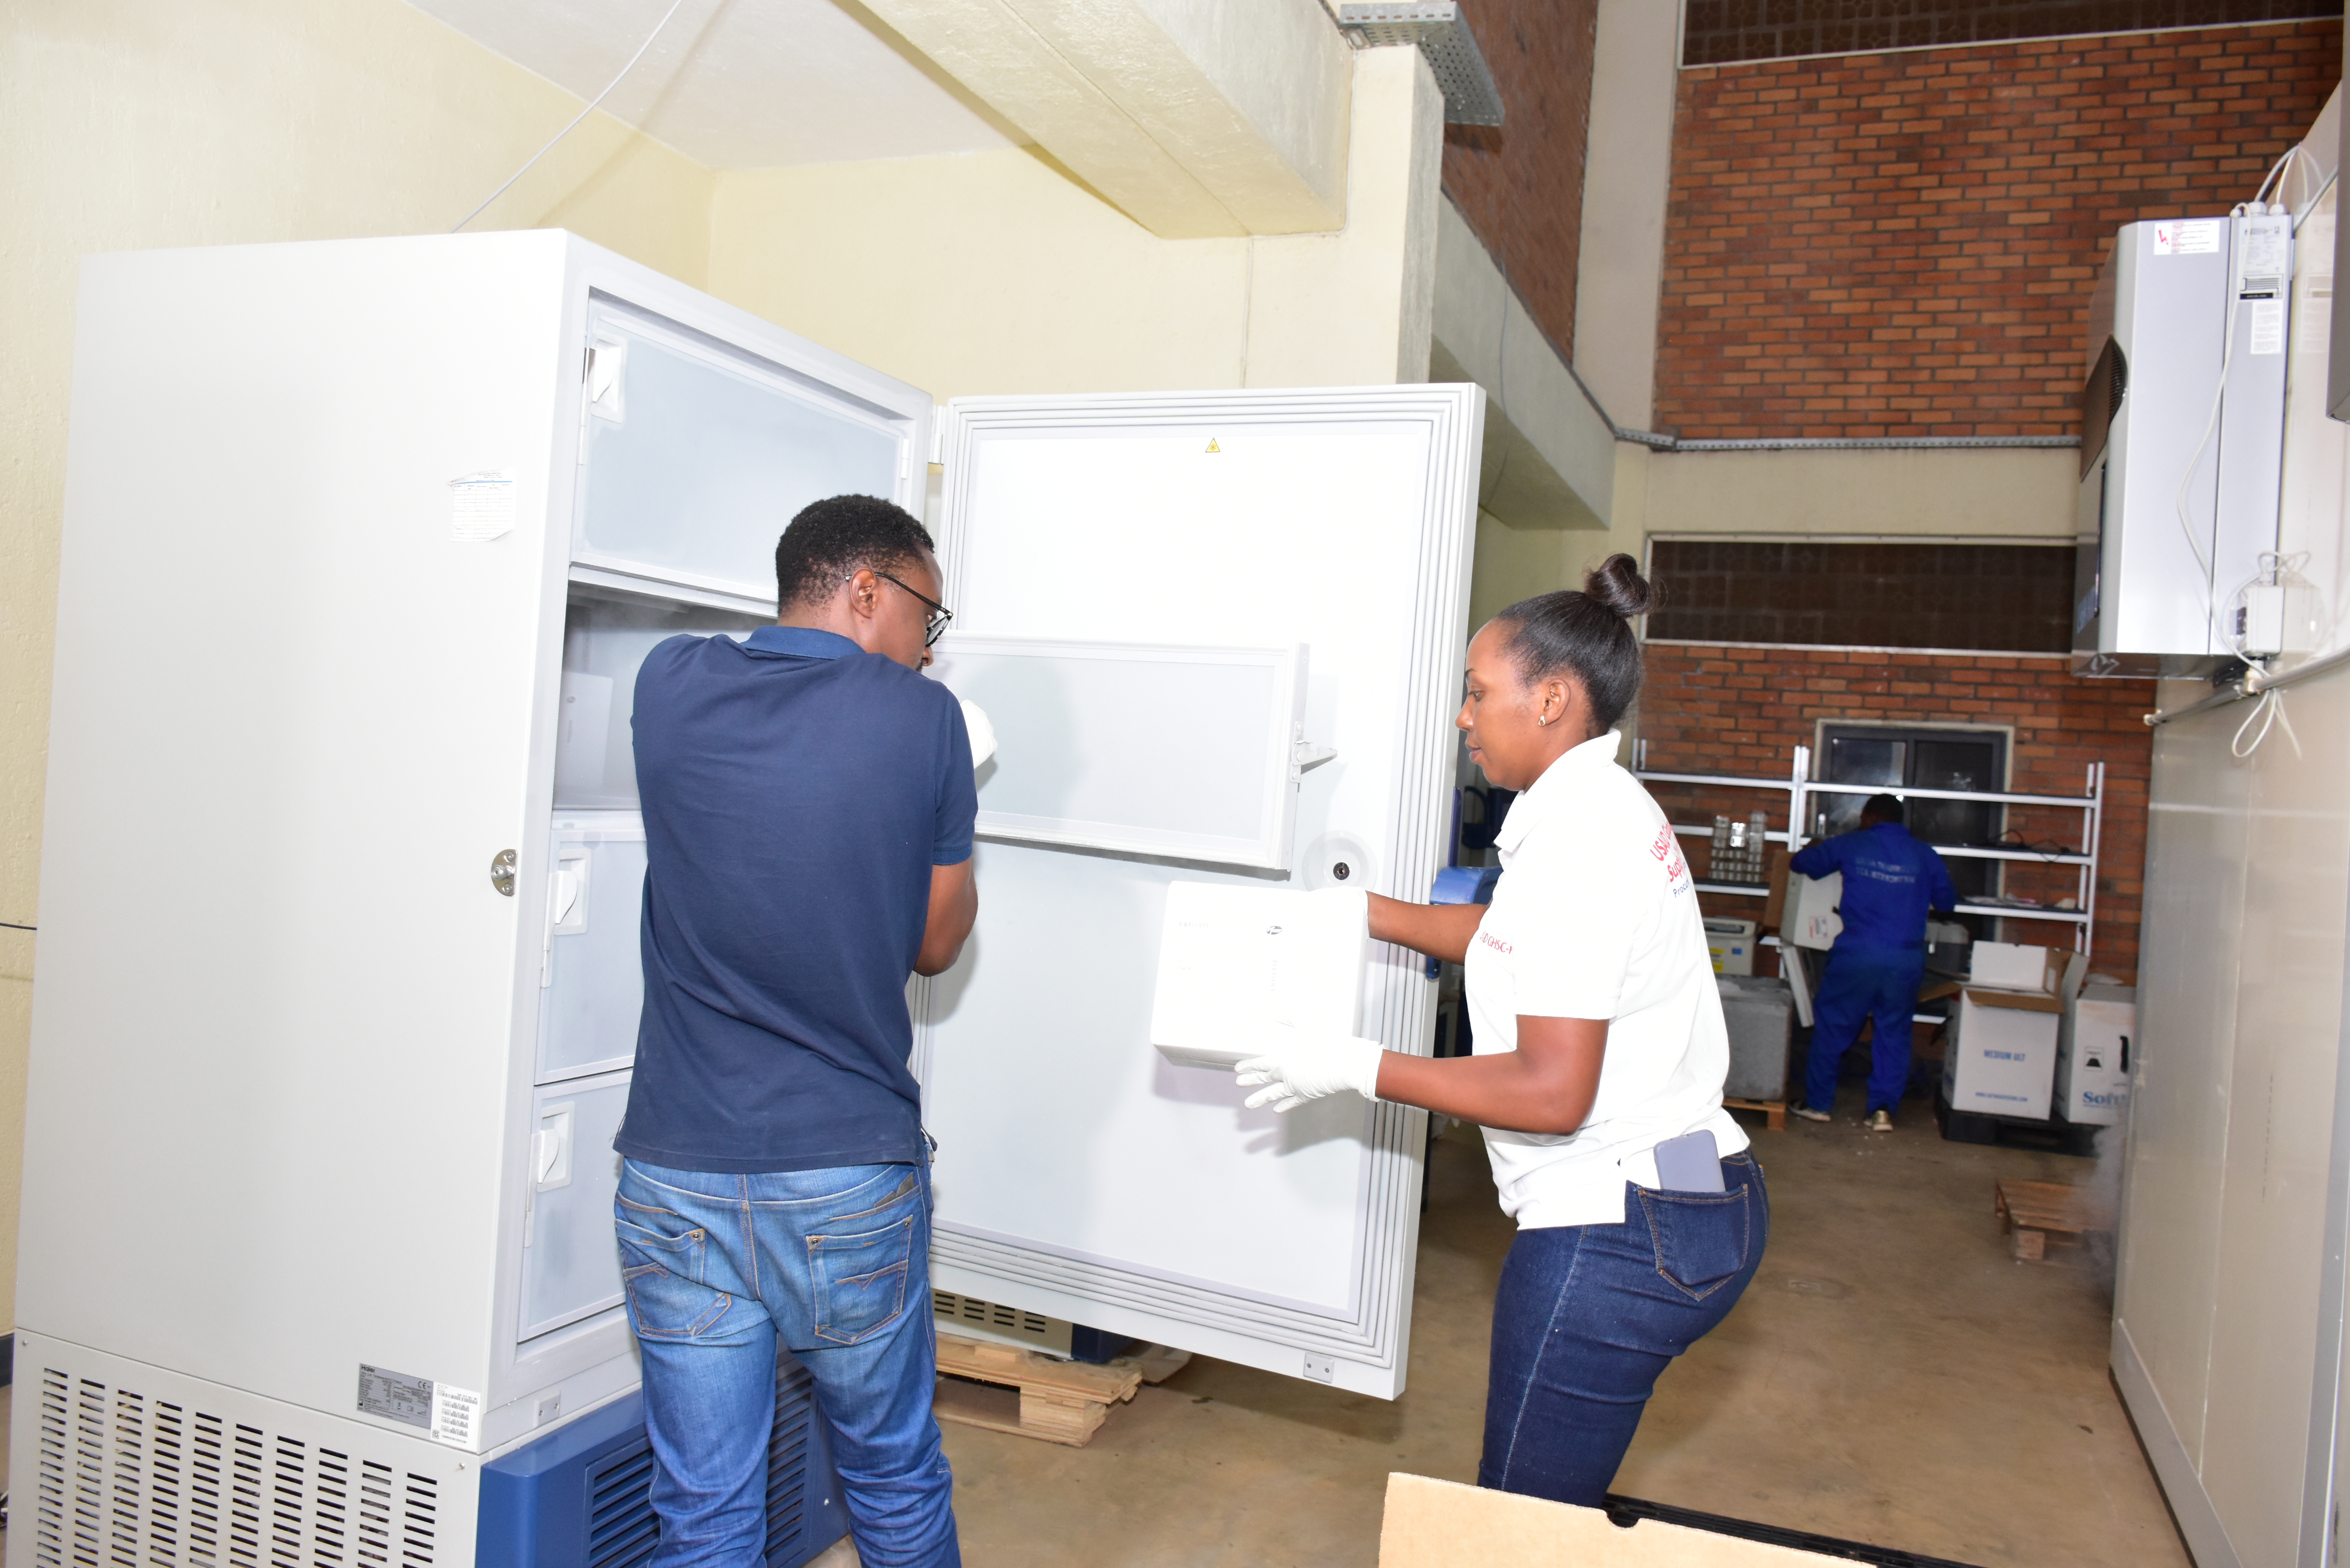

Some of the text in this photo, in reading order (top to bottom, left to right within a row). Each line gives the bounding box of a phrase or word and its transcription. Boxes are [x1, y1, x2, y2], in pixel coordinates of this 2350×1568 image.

[1650, 831, 1671, 861] USAID
[1266, 926, 1282, 935] Pfizer
[1984, 1049, 2011, 1060] MEDIUM
[361, 1365, 376, 1373] Haier
